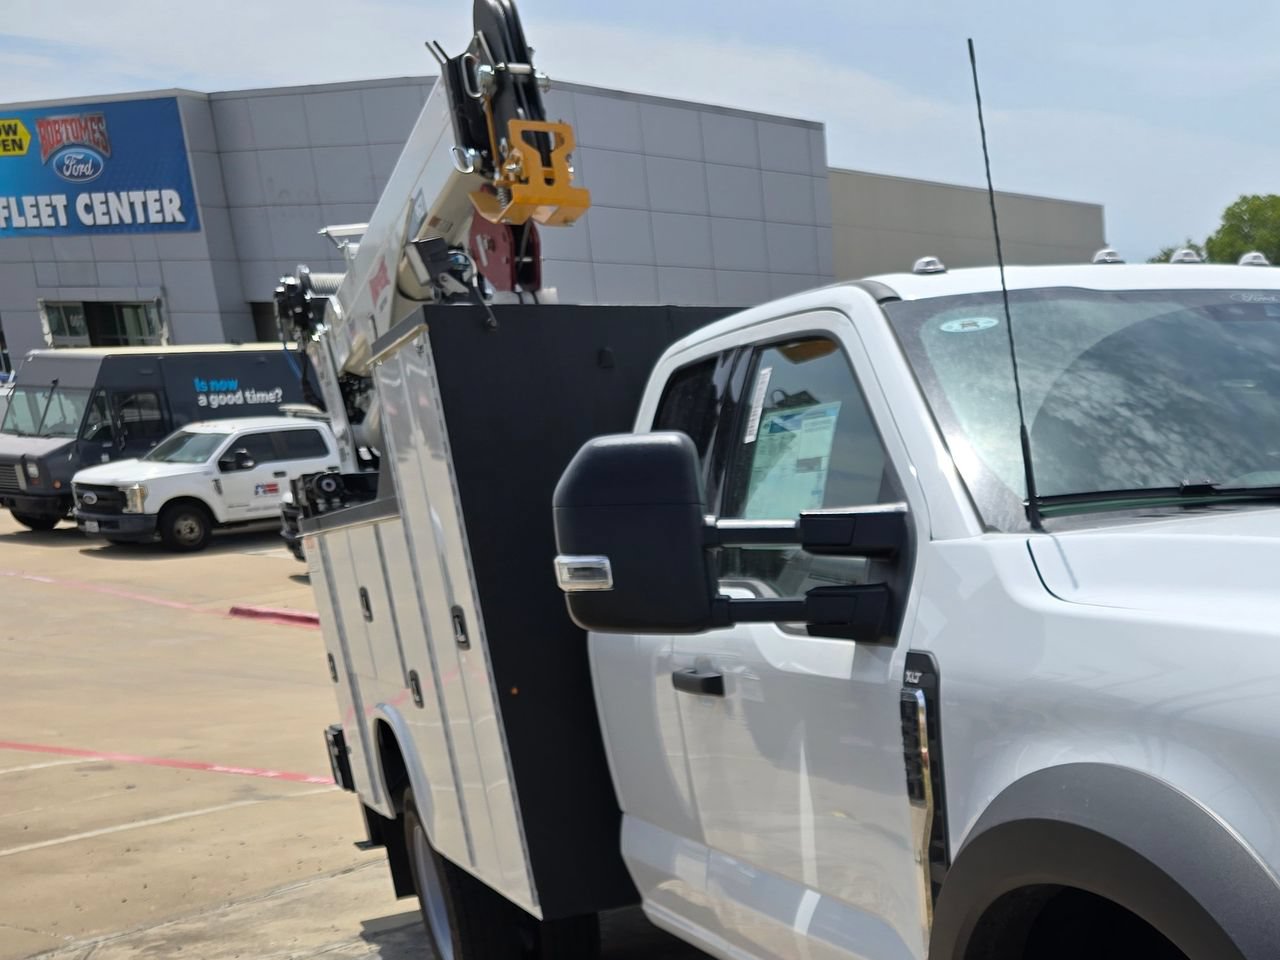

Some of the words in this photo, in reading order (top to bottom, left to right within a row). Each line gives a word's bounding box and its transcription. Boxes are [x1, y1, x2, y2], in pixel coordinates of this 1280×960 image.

[63, 153, 93, 176] Ford
[0, 194, 68, 228] FLEET
[75, 189, 186, 226] CENTER
[209, 379, 239, 392] now
[198, 394, 208, 407] a
[209, 388, 244, 408] good
[244, 387, 283, 404] time?
[905, 671, 922, 684] XLT
